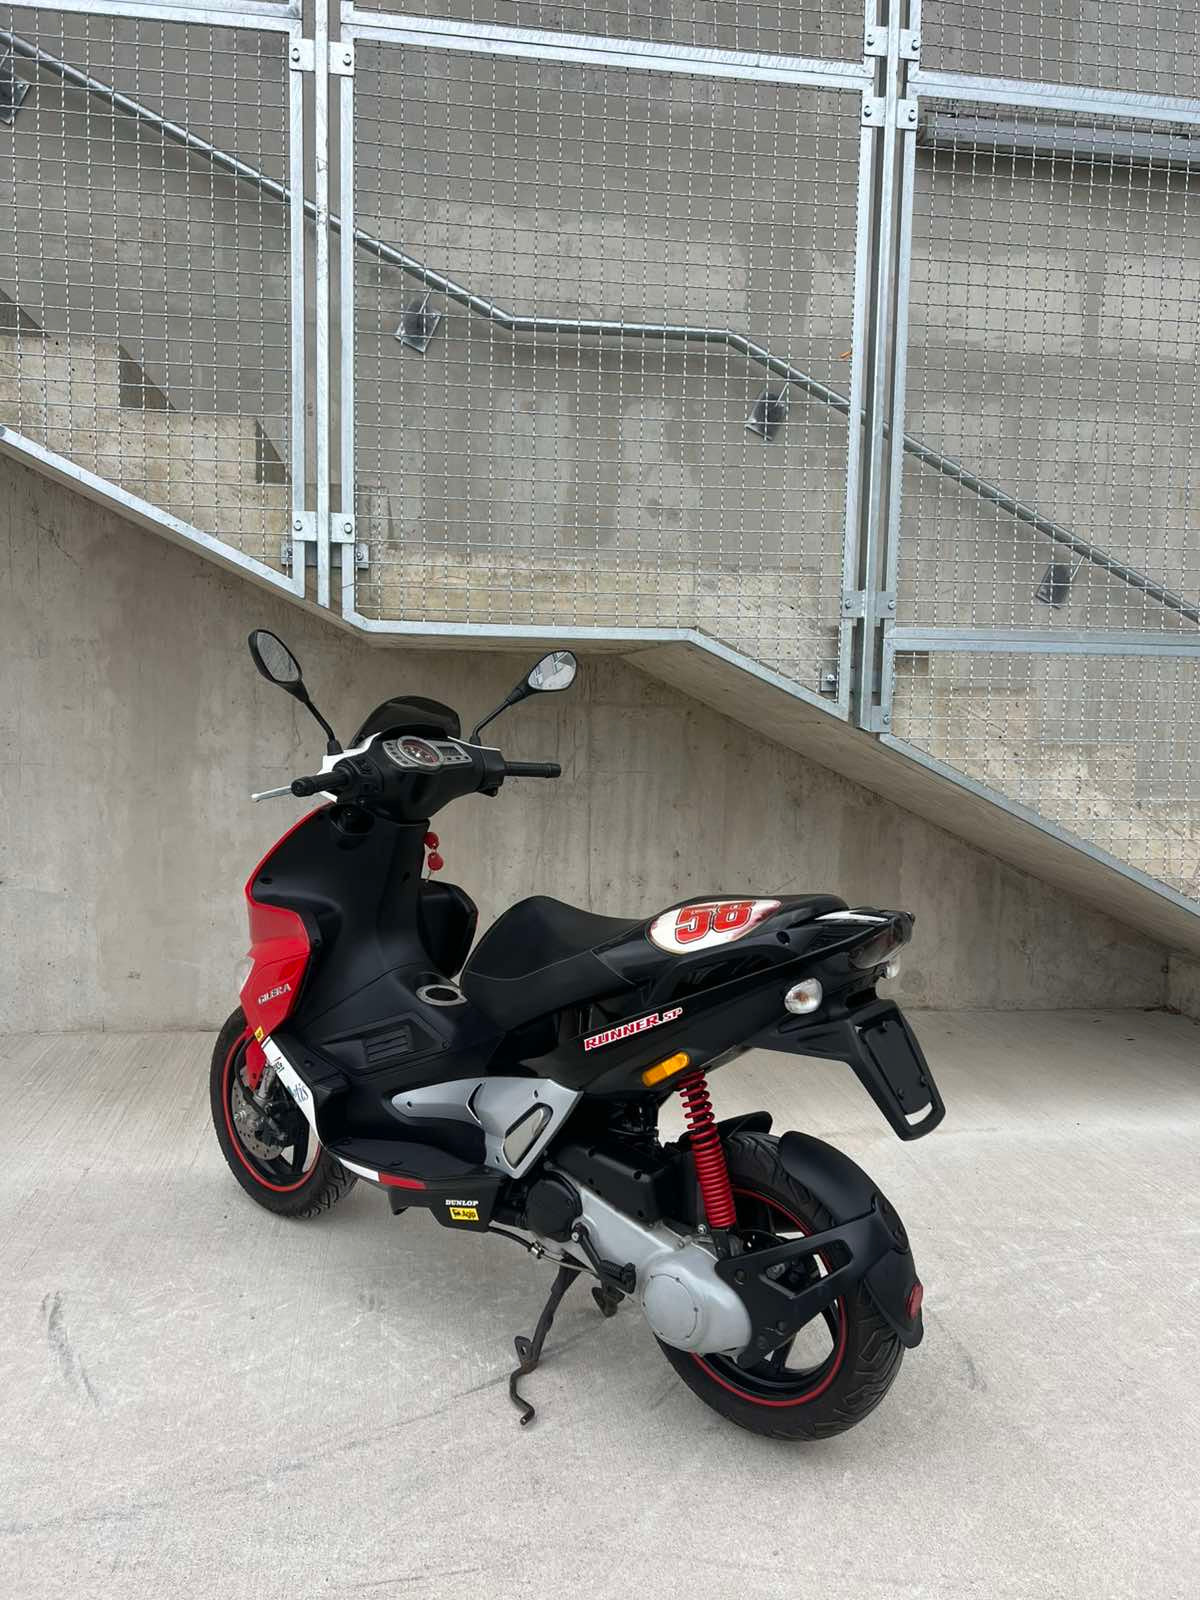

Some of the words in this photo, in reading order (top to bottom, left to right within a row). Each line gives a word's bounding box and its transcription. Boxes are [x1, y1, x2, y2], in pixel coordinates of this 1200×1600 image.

[676, 902, 755, 944] 58
[258, 983, 291, 1004] GILERA
[584, 1013, 660, 1051] RUNNER
[662, 1007, 683, 1021] SP
